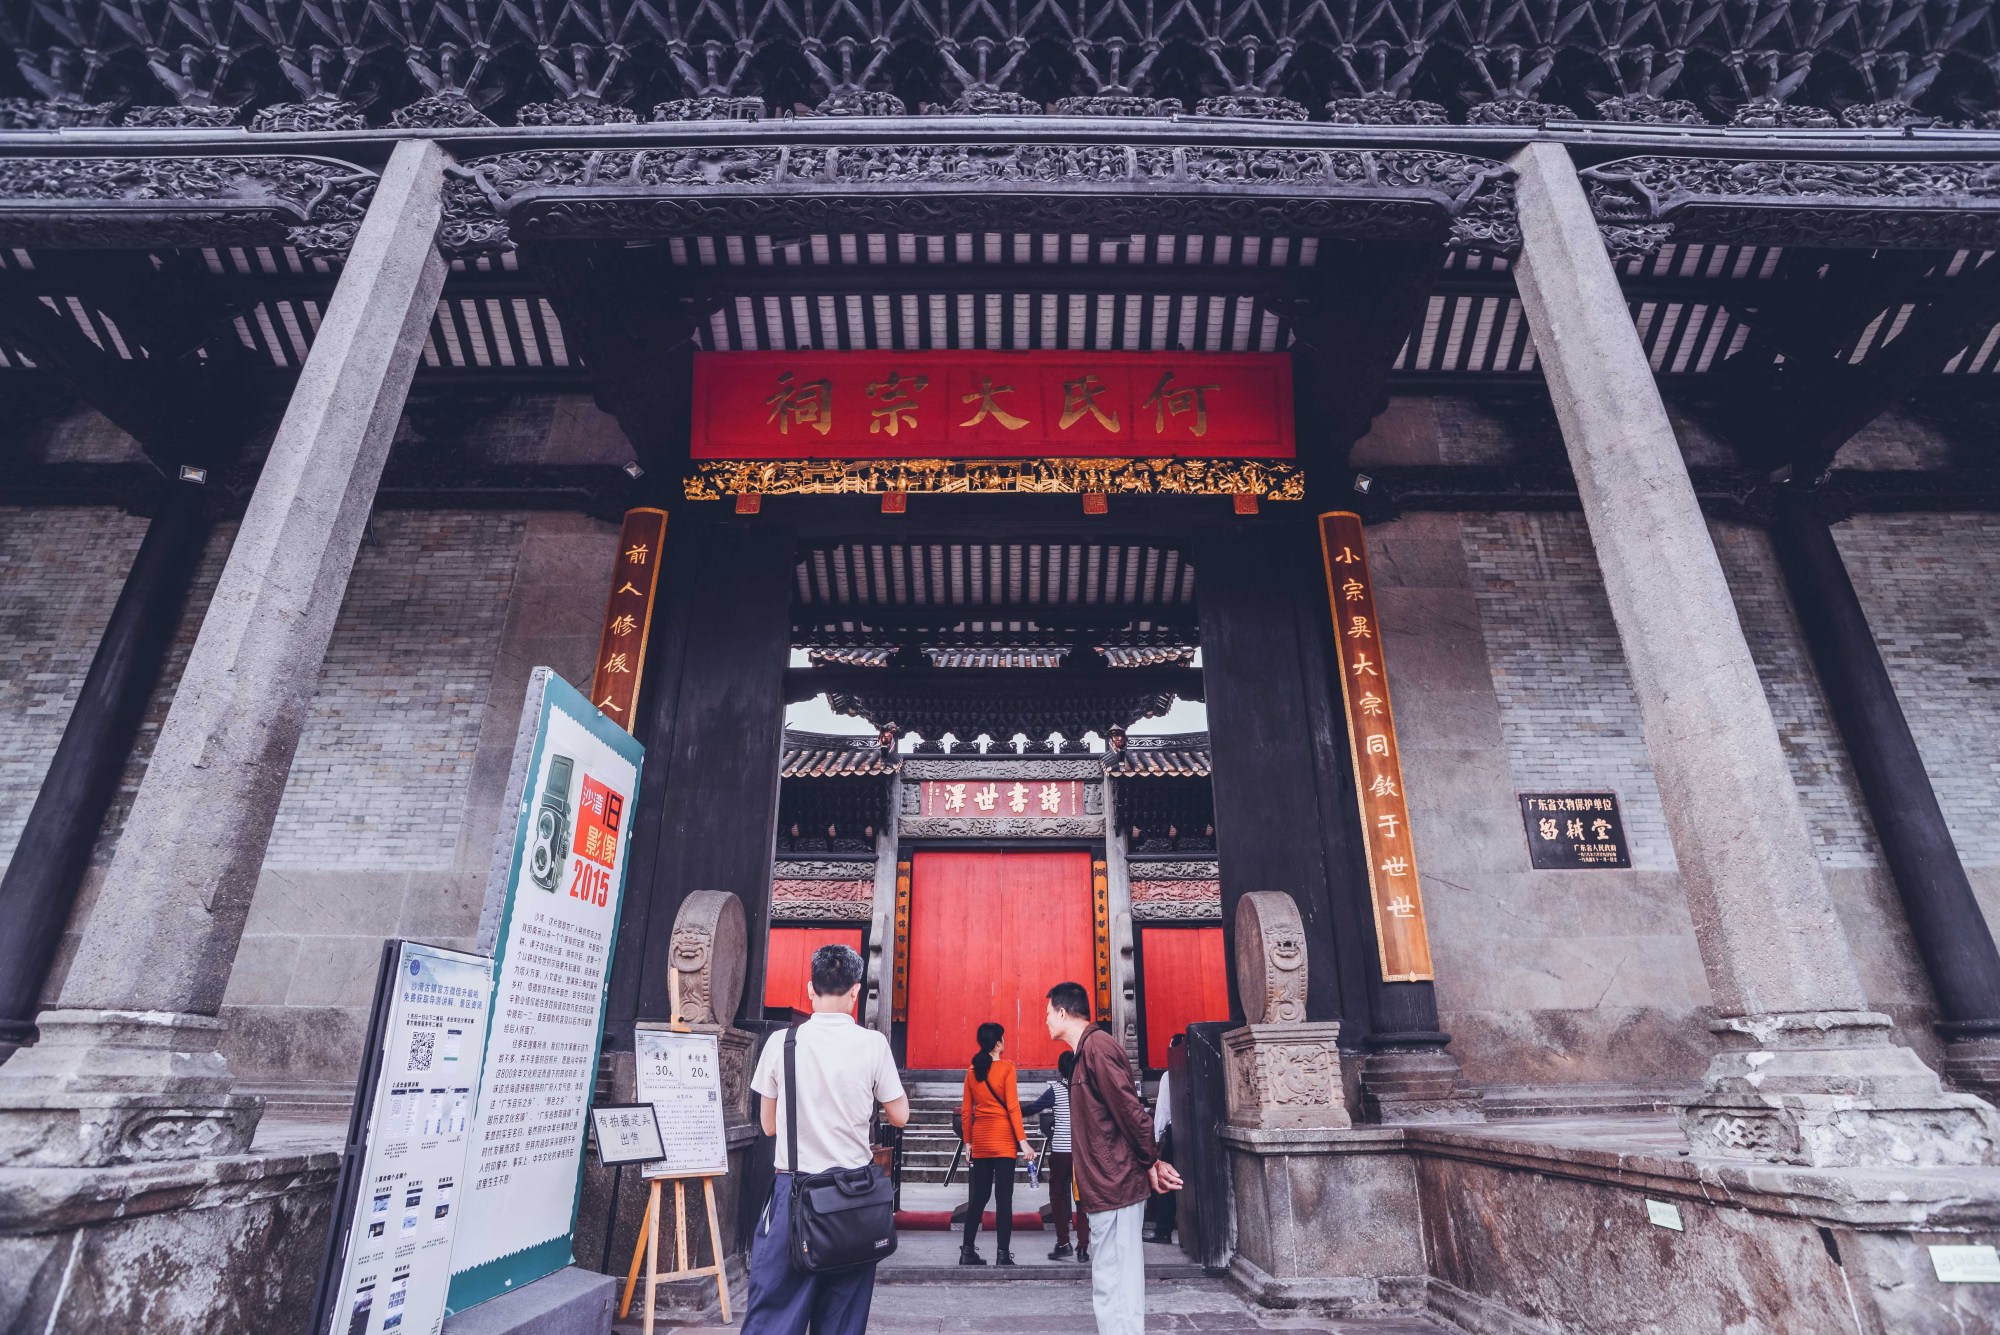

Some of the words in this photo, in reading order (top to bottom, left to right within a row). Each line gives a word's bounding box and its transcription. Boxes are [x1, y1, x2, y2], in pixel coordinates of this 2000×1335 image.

[766, 369, 1221, 438] 何氏大宗祠
[944, 781, 1061, 814] 詩書世澤
[1528, 798, 1613, 812] 广东省文物保护单位
[585, 824, 618, 864] 影像
[569, 858, 610, 908] 2015
[598, 1113, 651, 1129] 有拍摄道具
[620, 1131, 639, 1146] 出售
